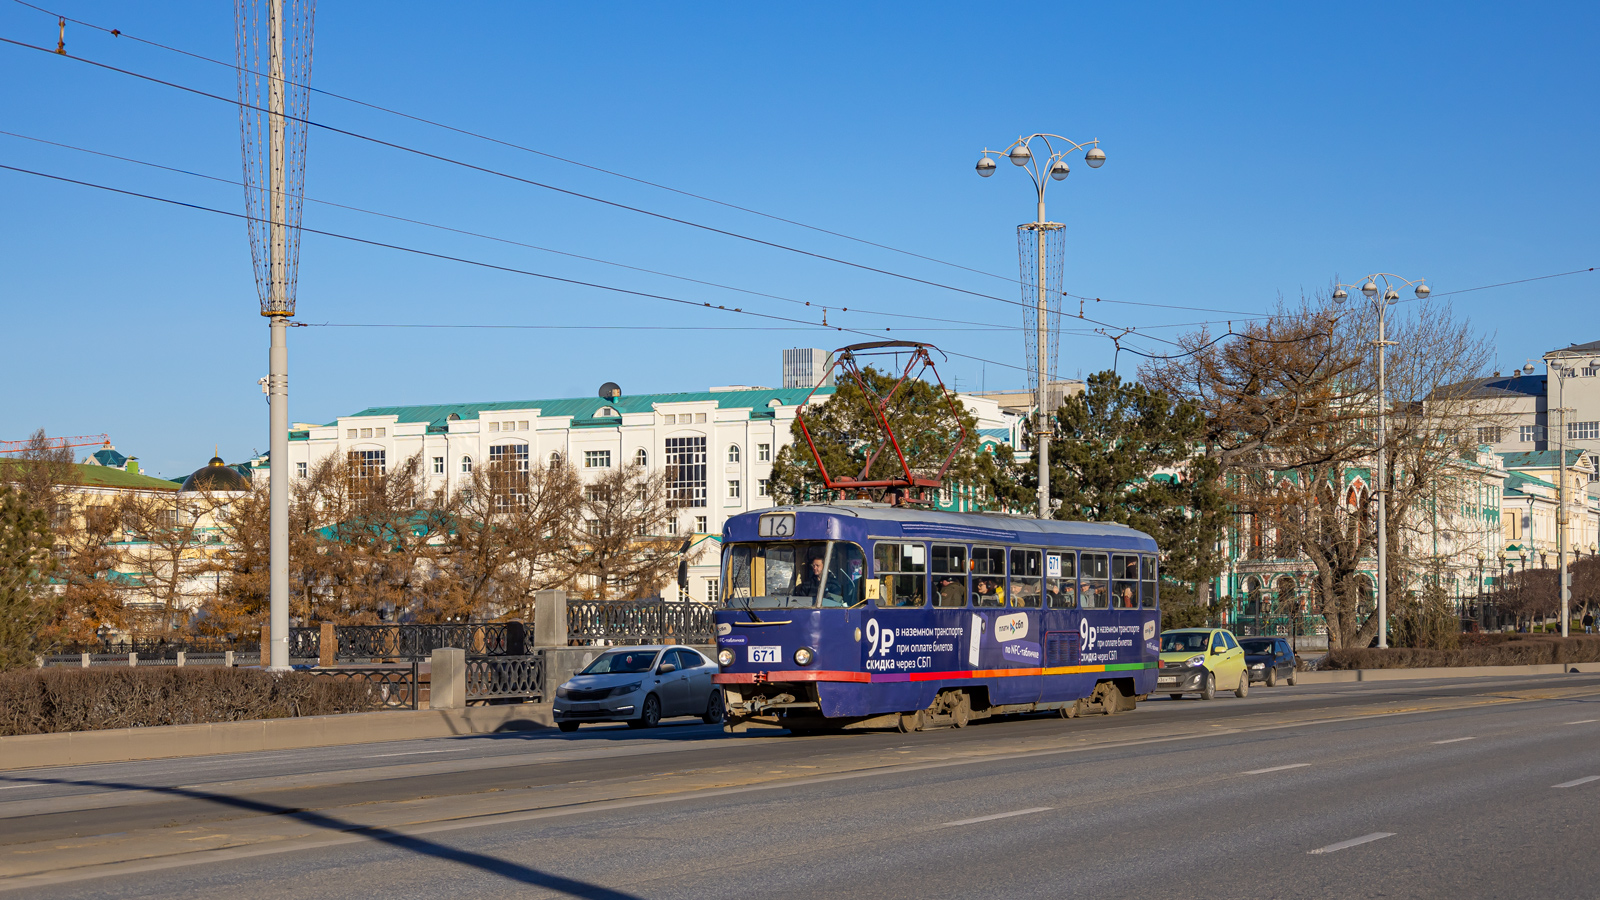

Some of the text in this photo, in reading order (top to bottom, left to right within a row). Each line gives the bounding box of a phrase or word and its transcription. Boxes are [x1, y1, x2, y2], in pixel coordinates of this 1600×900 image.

[770, 517, 787, 536] 16
[1049, 557, 1059, 570] 671
[895, 627, 963, 639] в наземном транспорте
[896, 640, 954, 656] при оплате билетов
[1005, 646, 1011, 654] по
[753, 650, 775, 662] 671
[866, 659, 895, 671] скидка
[896, 656, 932, 672] через СБП
